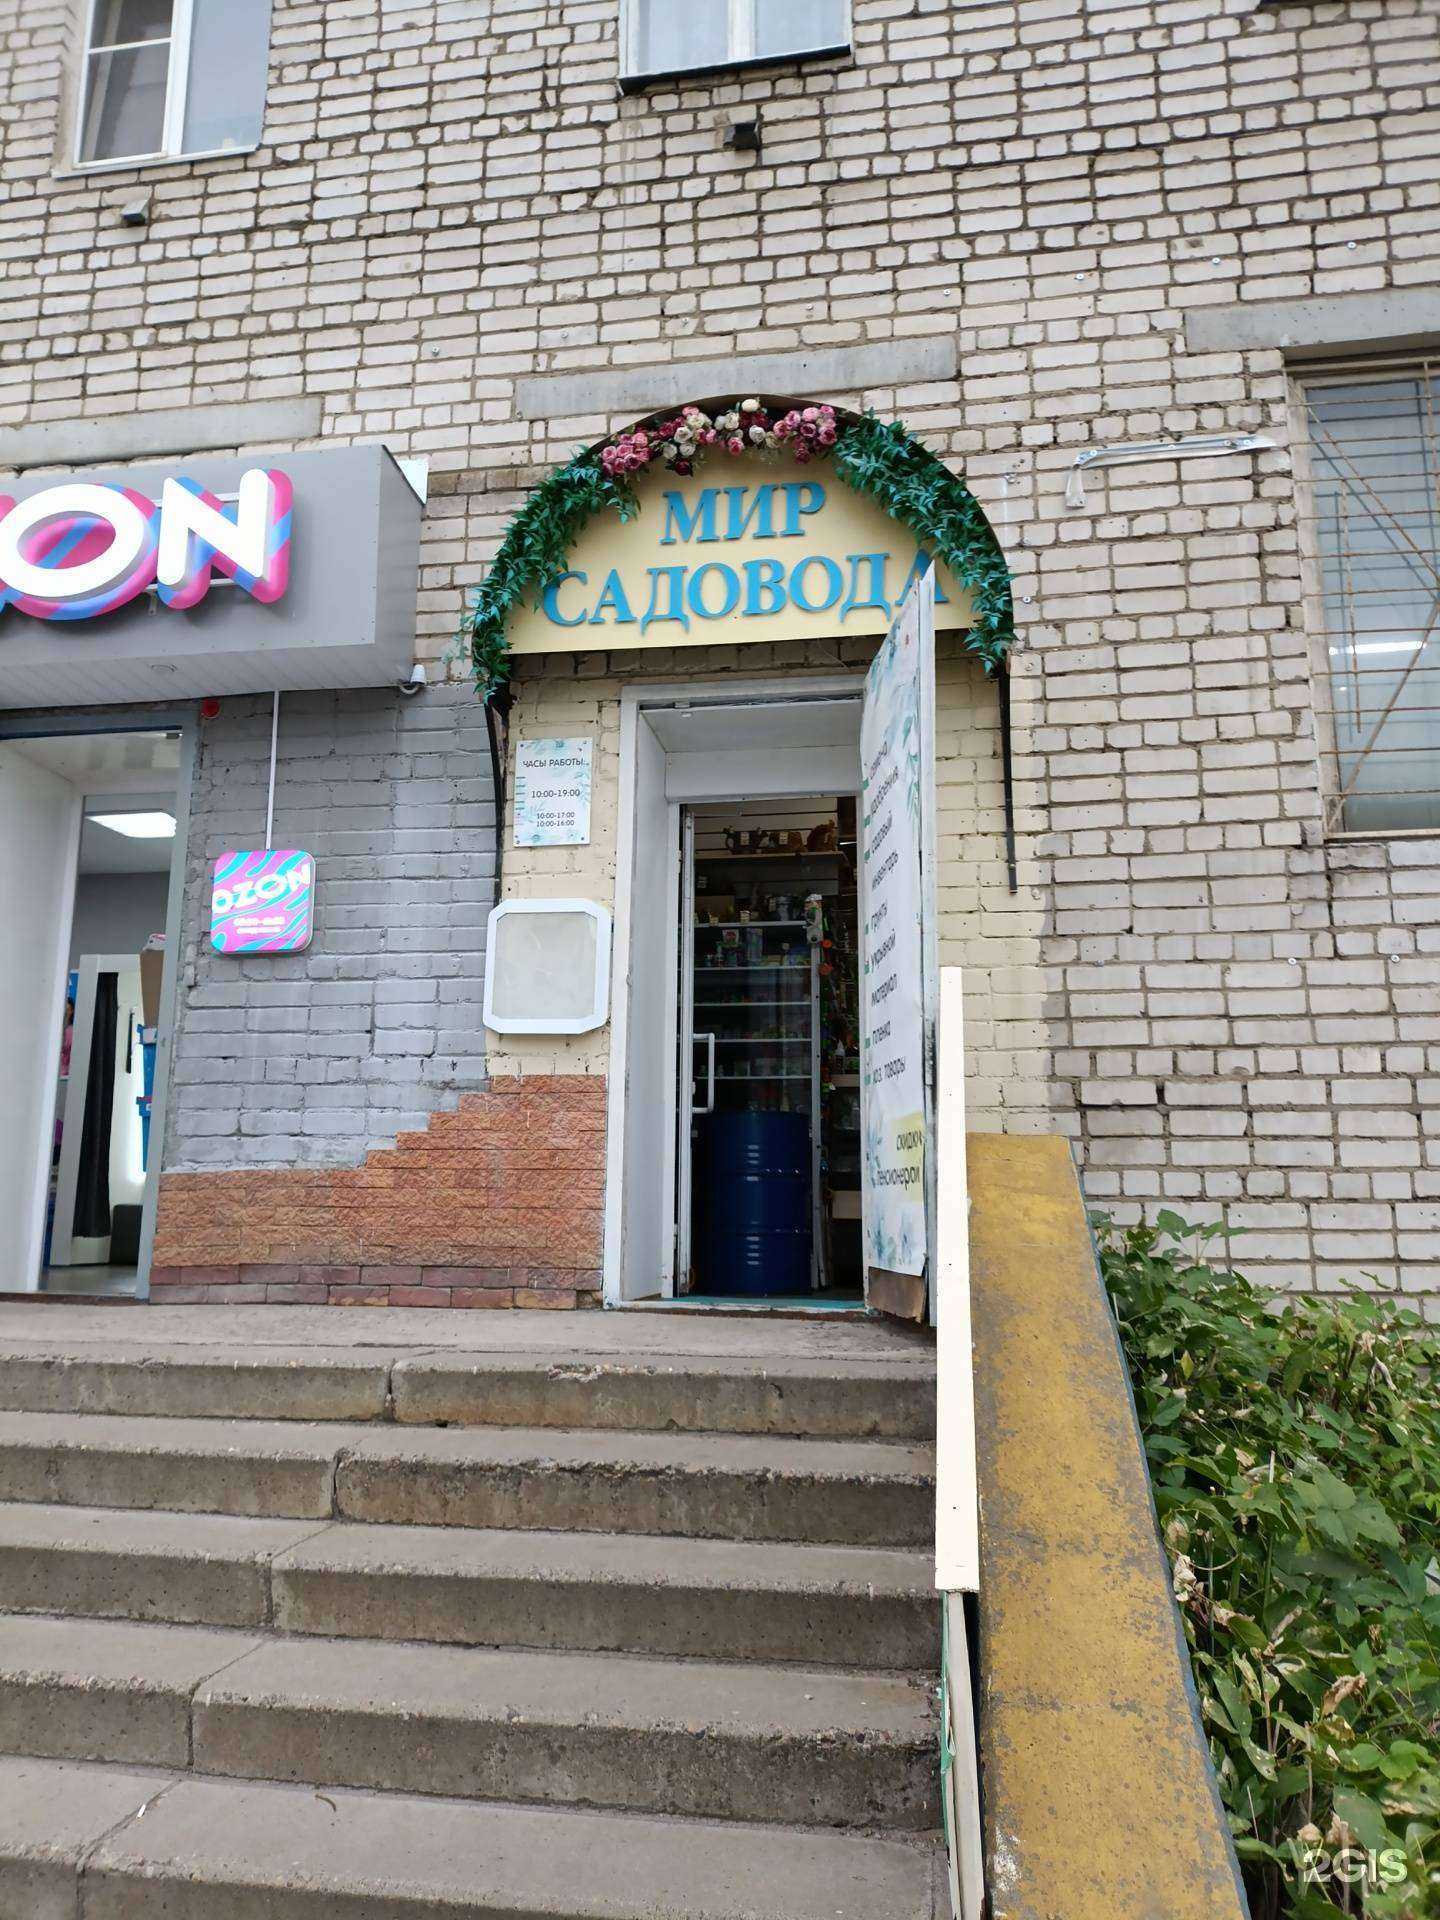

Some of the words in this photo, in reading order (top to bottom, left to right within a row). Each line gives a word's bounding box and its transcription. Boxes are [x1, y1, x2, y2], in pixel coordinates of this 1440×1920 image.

[0, 468, 294, 620] ON
[659, 480, 827, 546] МИР
[542, 547, 950, 636] САДОВОДА
[522, 759, 547, 768] ЧАСЫ
[531, 788, 581, 799] 10:00-19:00
